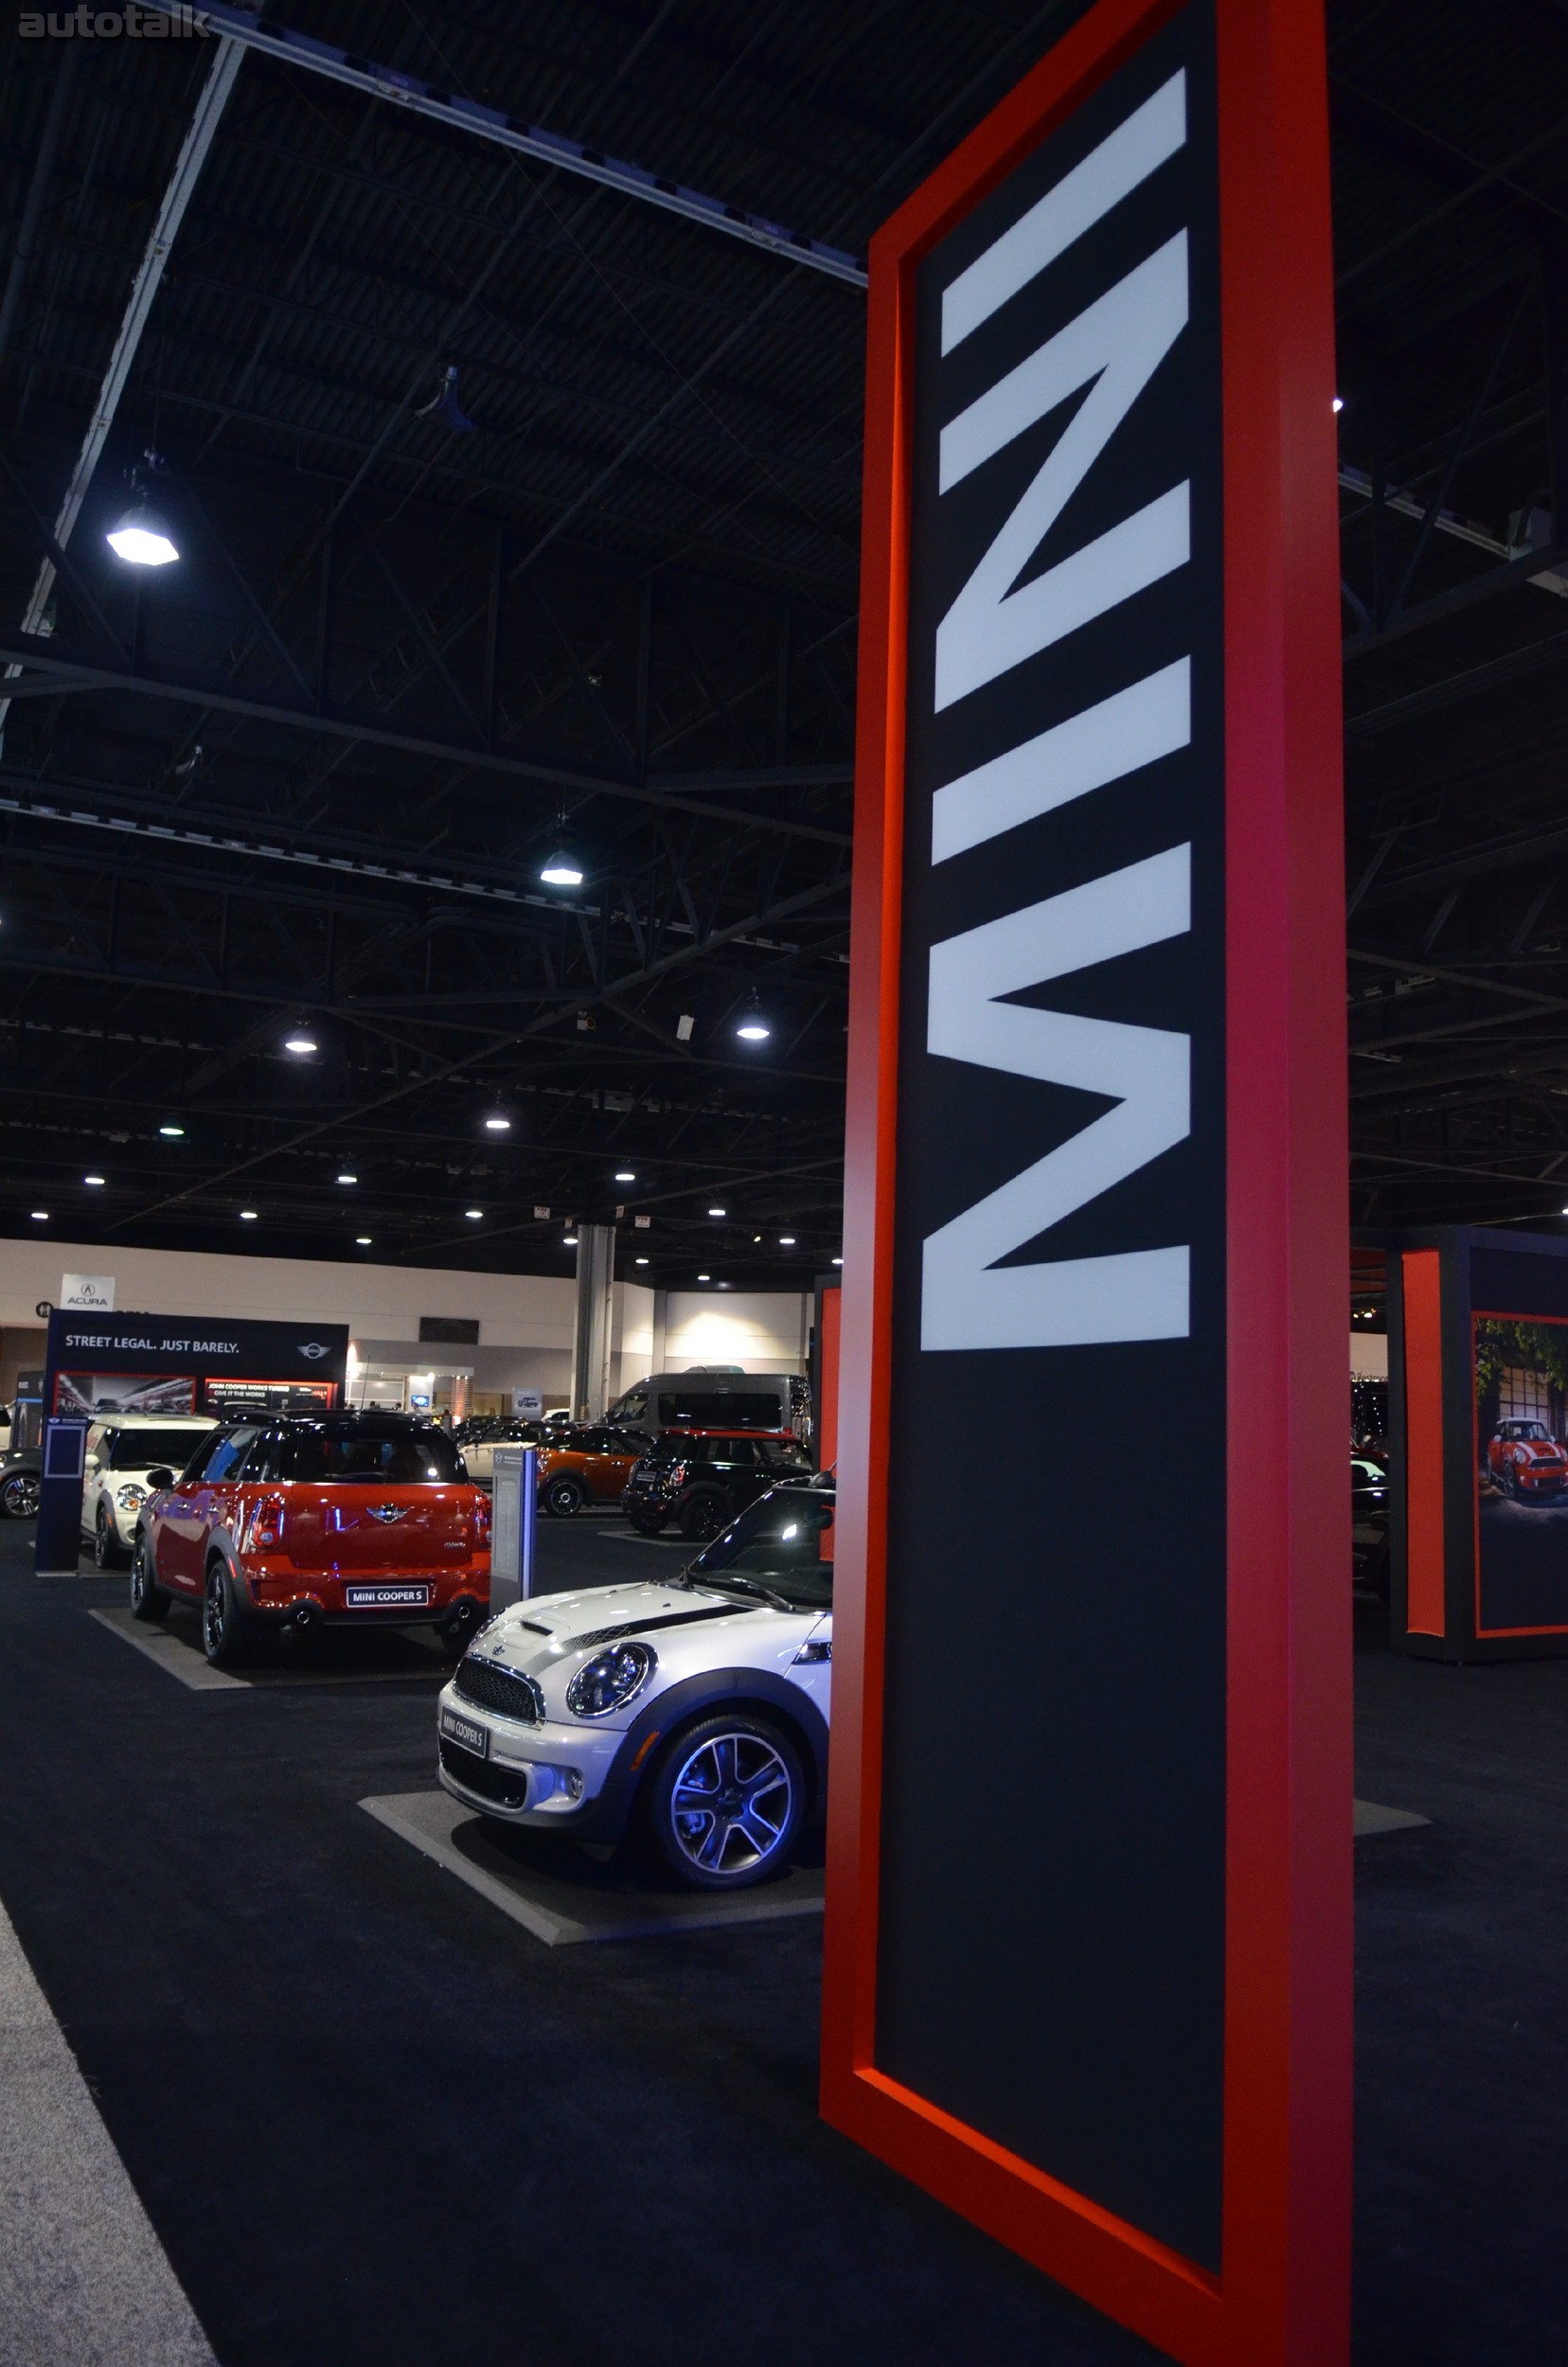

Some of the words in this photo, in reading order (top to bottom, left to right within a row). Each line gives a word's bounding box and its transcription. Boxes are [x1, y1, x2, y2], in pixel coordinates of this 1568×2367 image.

[920, 66, 1189, 1352] MINI
[67, 1297, 108, 1306] ACURA
[65, 1335, 112, 1347] STREET
[114, 1338, 157, 1350] LEGAL.
[159, 1340, 190, 1352] JUST
[192, 1341, 240, 1353] BARELY.
[353, 1593, 375, 1602] MINI
[377, 1592, 415, 1601] COOPER
[416, 1591, 422, 1600] S
[443, 1715, 455, 1733] MINI
[455, 1721, 477, 1745] COOPER
[476, 1733, 483, 1747] S
